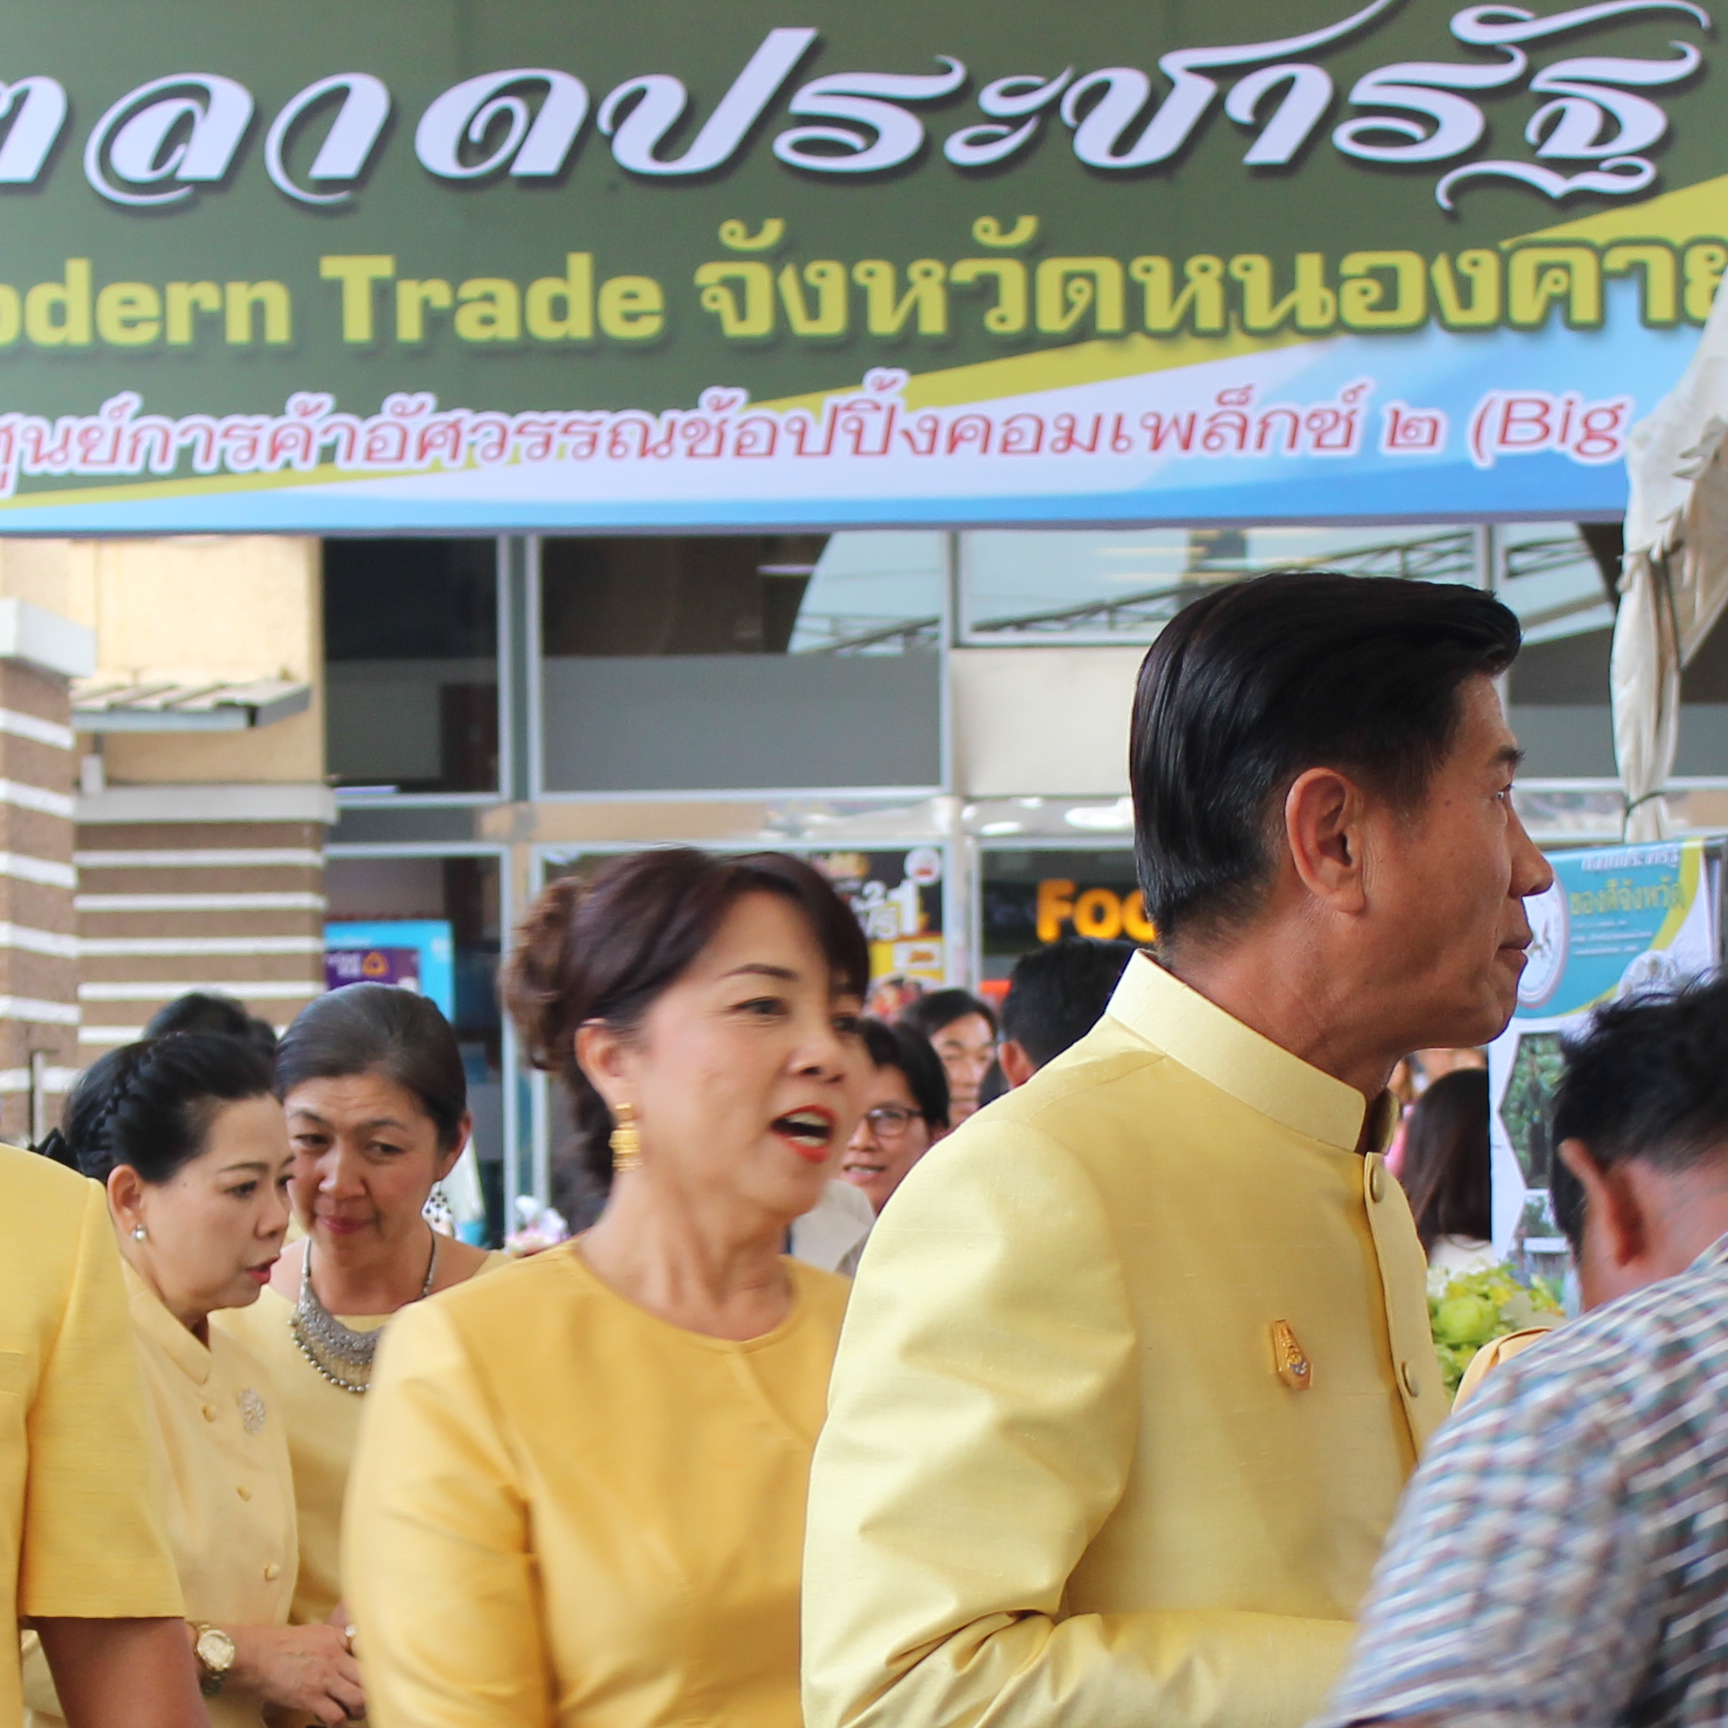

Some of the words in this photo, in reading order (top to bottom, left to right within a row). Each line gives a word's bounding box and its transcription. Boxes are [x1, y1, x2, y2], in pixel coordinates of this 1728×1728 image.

[320, 252, 663, 344] Trade
[1384, 403, 1440, 454] ๒
[1470, 391, 1625, 464] (Big
